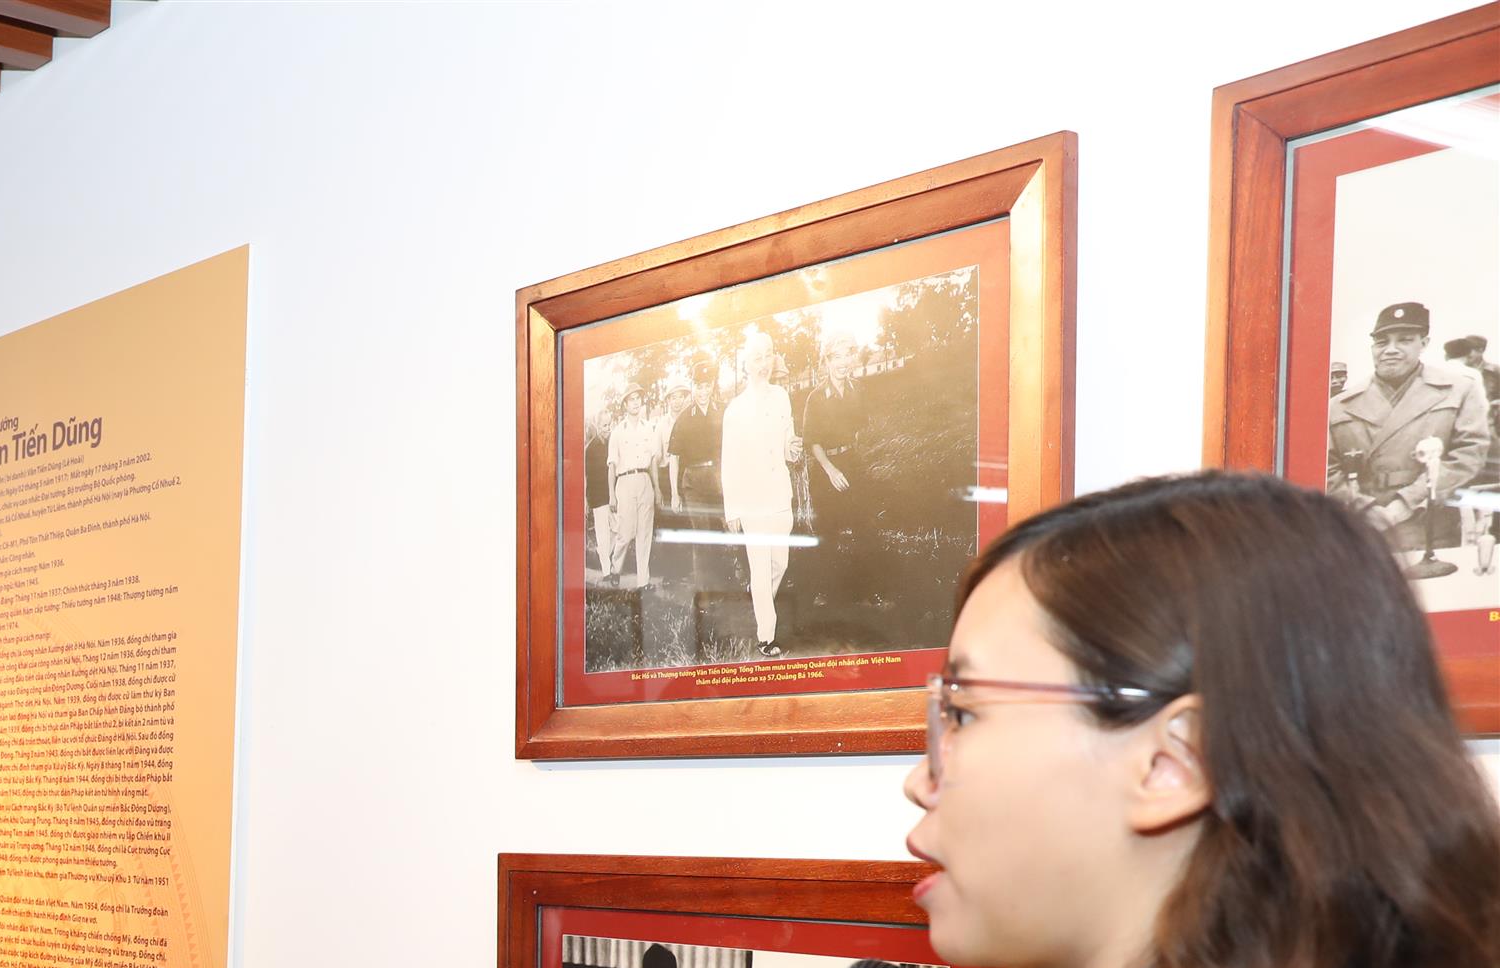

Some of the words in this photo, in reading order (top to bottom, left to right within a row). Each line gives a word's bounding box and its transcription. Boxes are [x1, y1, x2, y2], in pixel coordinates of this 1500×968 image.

[12, 424, 47, 461] Tiến
[52, 416, 102, 450] Dũng
[95, 464, 101, 472] 17
[119, 459, 122, 468] 3
[136, 452, 152, 463] 2002.
[125, 575, 140, 584] 1938.
[160, 646, 176, 654] tham
[871, 657, 884, 665] Việt
